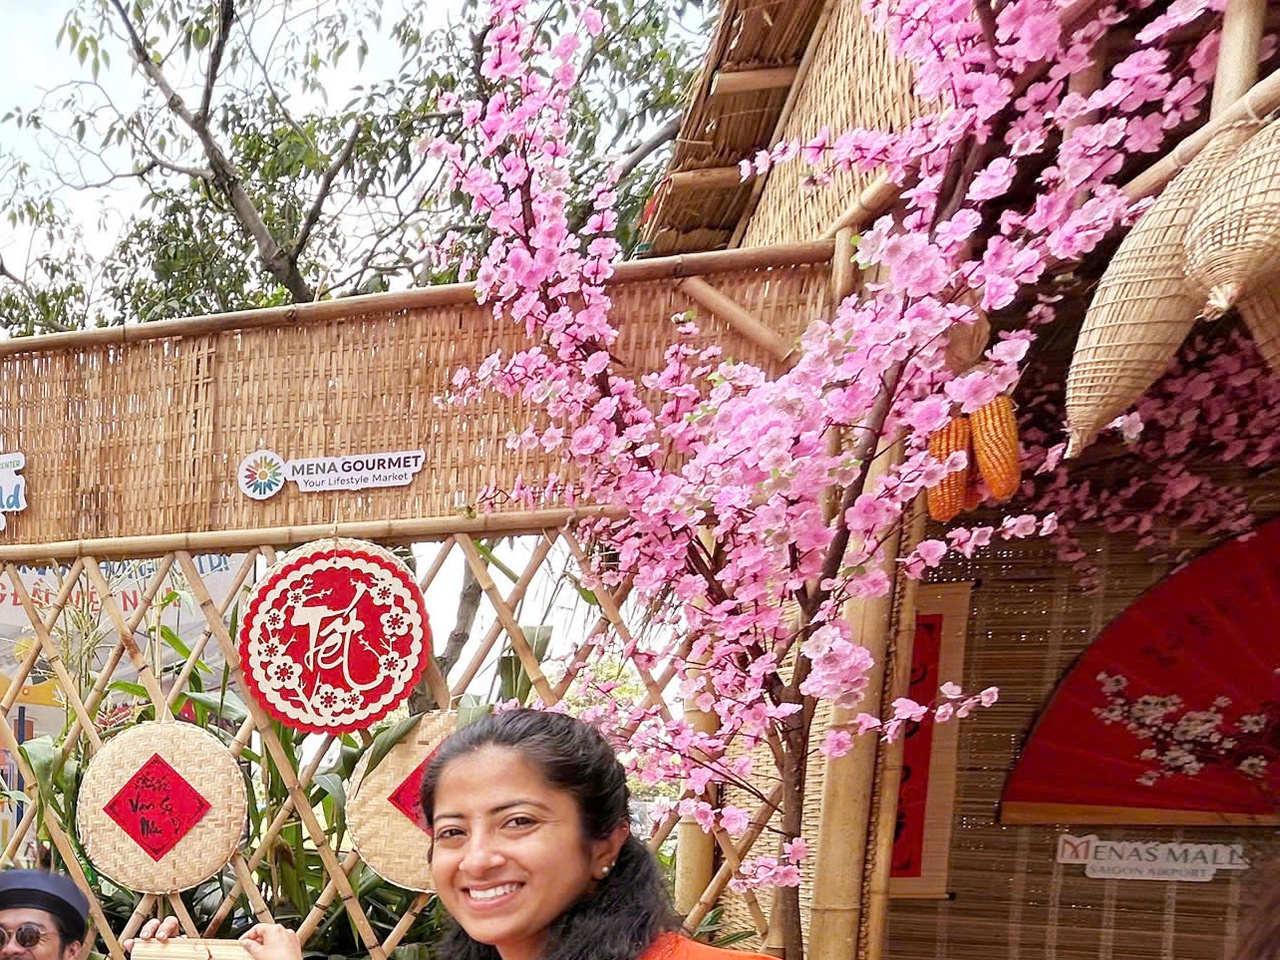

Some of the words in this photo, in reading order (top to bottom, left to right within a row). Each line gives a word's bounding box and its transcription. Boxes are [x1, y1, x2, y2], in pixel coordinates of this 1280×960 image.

[291, 462, 338, 477] MENA
[342, 455, 422, 472] GOURMET
[303, 479, 326, 488] Your
[328, 474, 370, 487] Lifestyle
[372, 471, 409, 483] Market
[291, 581, 386, 691] Tết
[1061, 839, 1159, 862] MENAS
